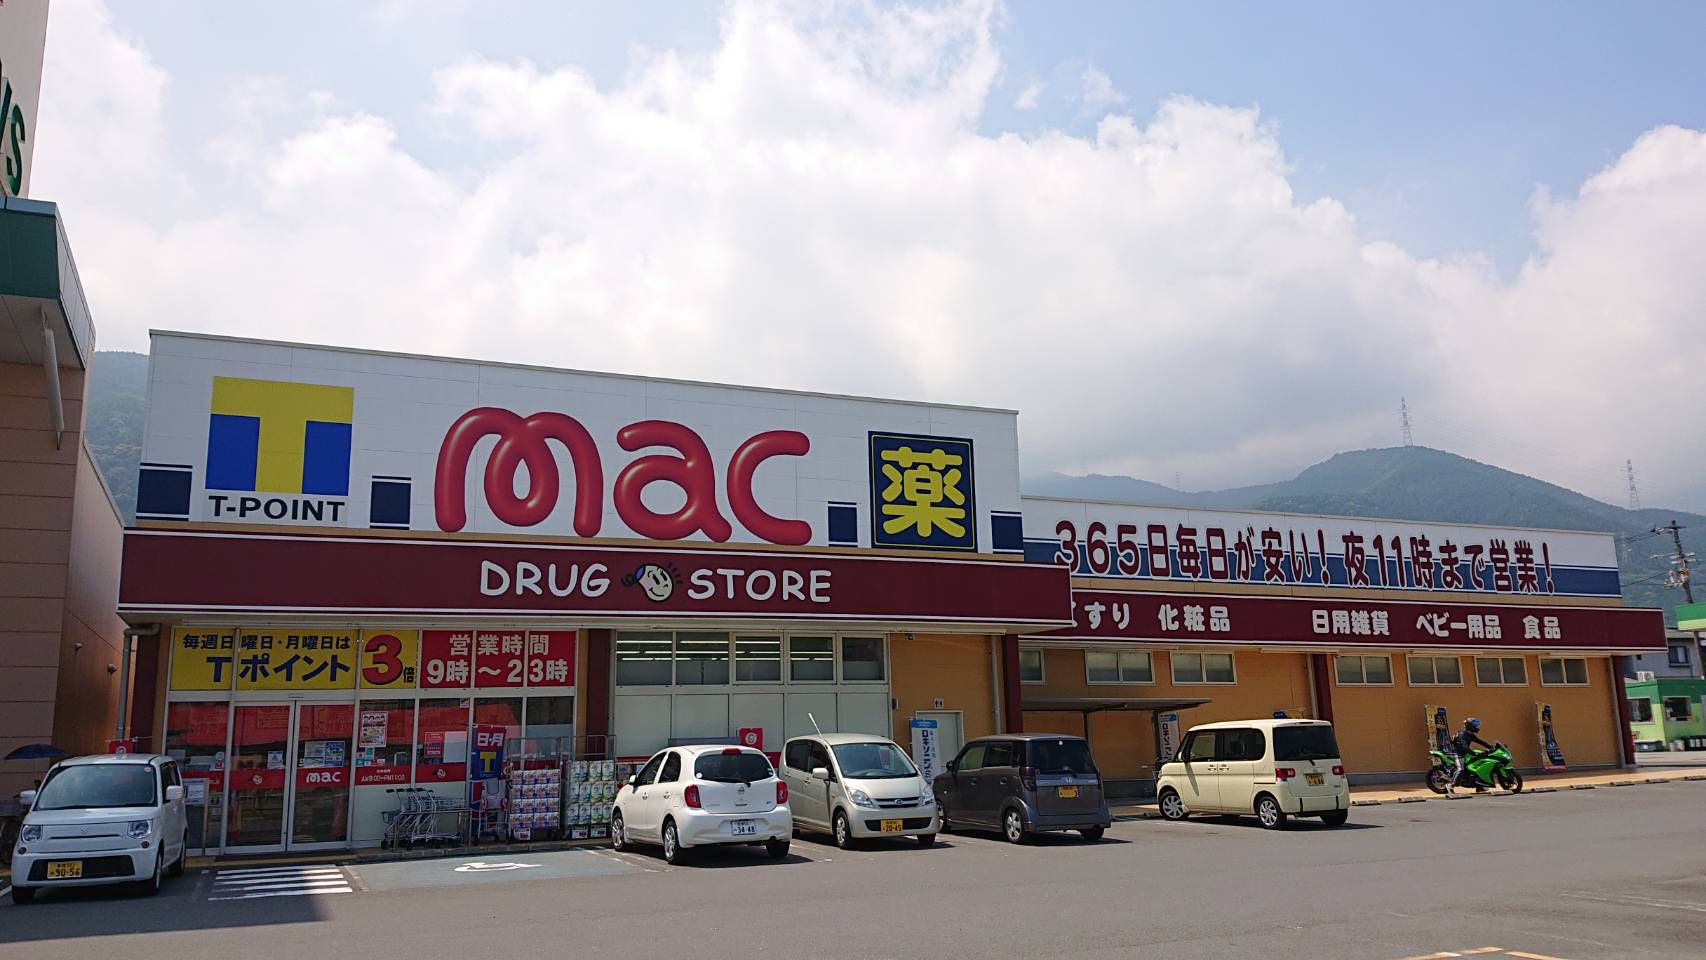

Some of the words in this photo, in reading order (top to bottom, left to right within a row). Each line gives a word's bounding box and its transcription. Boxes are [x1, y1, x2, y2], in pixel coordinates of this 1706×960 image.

[434, 406, 812, 546] mac
[880, 446, 966, 538] 薬
[208, 495, 346, 522] T-POINT
[479, 560, 611, 598] DRUG
[687, 568, 832, 602] STORE
[1157, 603, 1231, 633] 化粧品
[1311, 609, 1391, 637] 日用雑貨
[1415, 611, 1502, 640] ベビー用品
[1522, 615, 1562, 640] 食品
[449, 634, 550, 656] 営業時間
[206, 652, 350, 683] Tポイント
[305, 771, 342, 783] mac
[55, 868, 80, 877] 90-56
